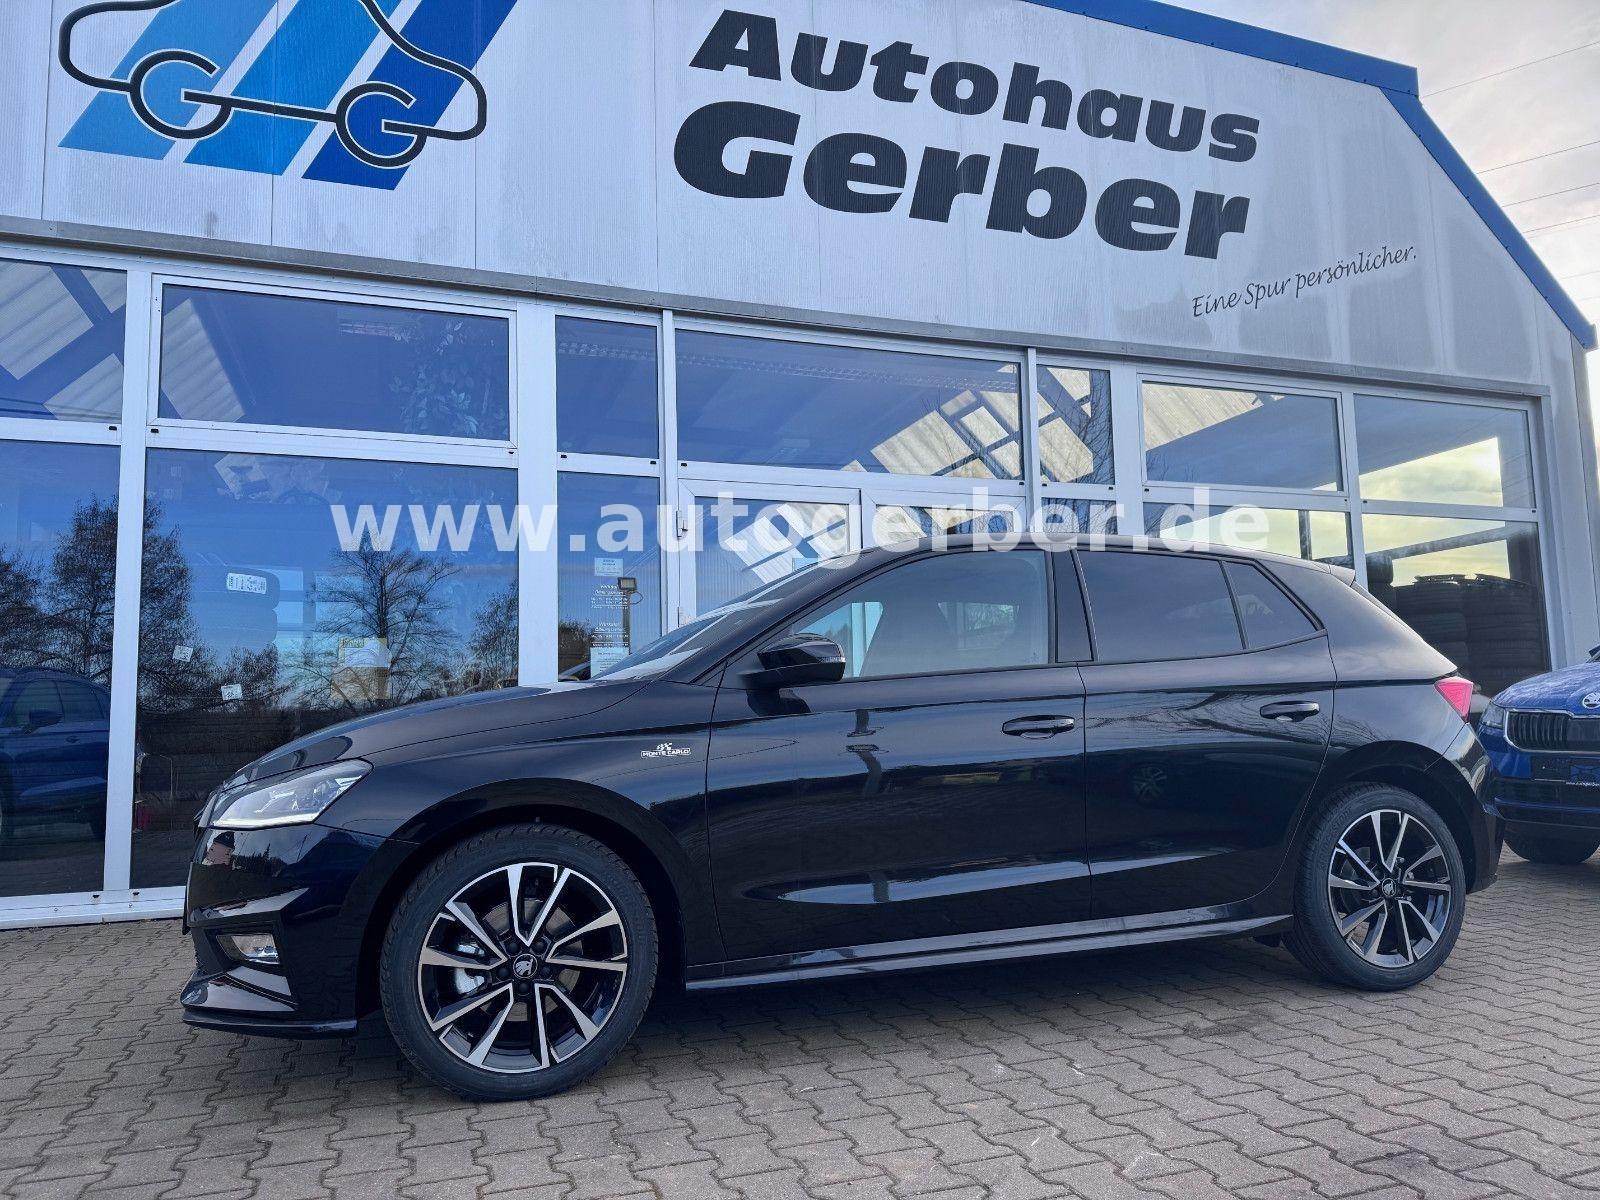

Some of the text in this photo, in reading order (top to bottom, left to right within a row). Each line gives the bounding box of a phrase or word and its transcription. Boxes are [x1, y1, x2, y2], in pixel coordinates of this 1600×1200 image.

[689, 9, 1260, 163] Autohaus
[673, 101, 1250, 260] Gerber
[1192, 245, 1417, 318] Eine Spur persönlicher.
[667, 748, 690, 756] CARLO
